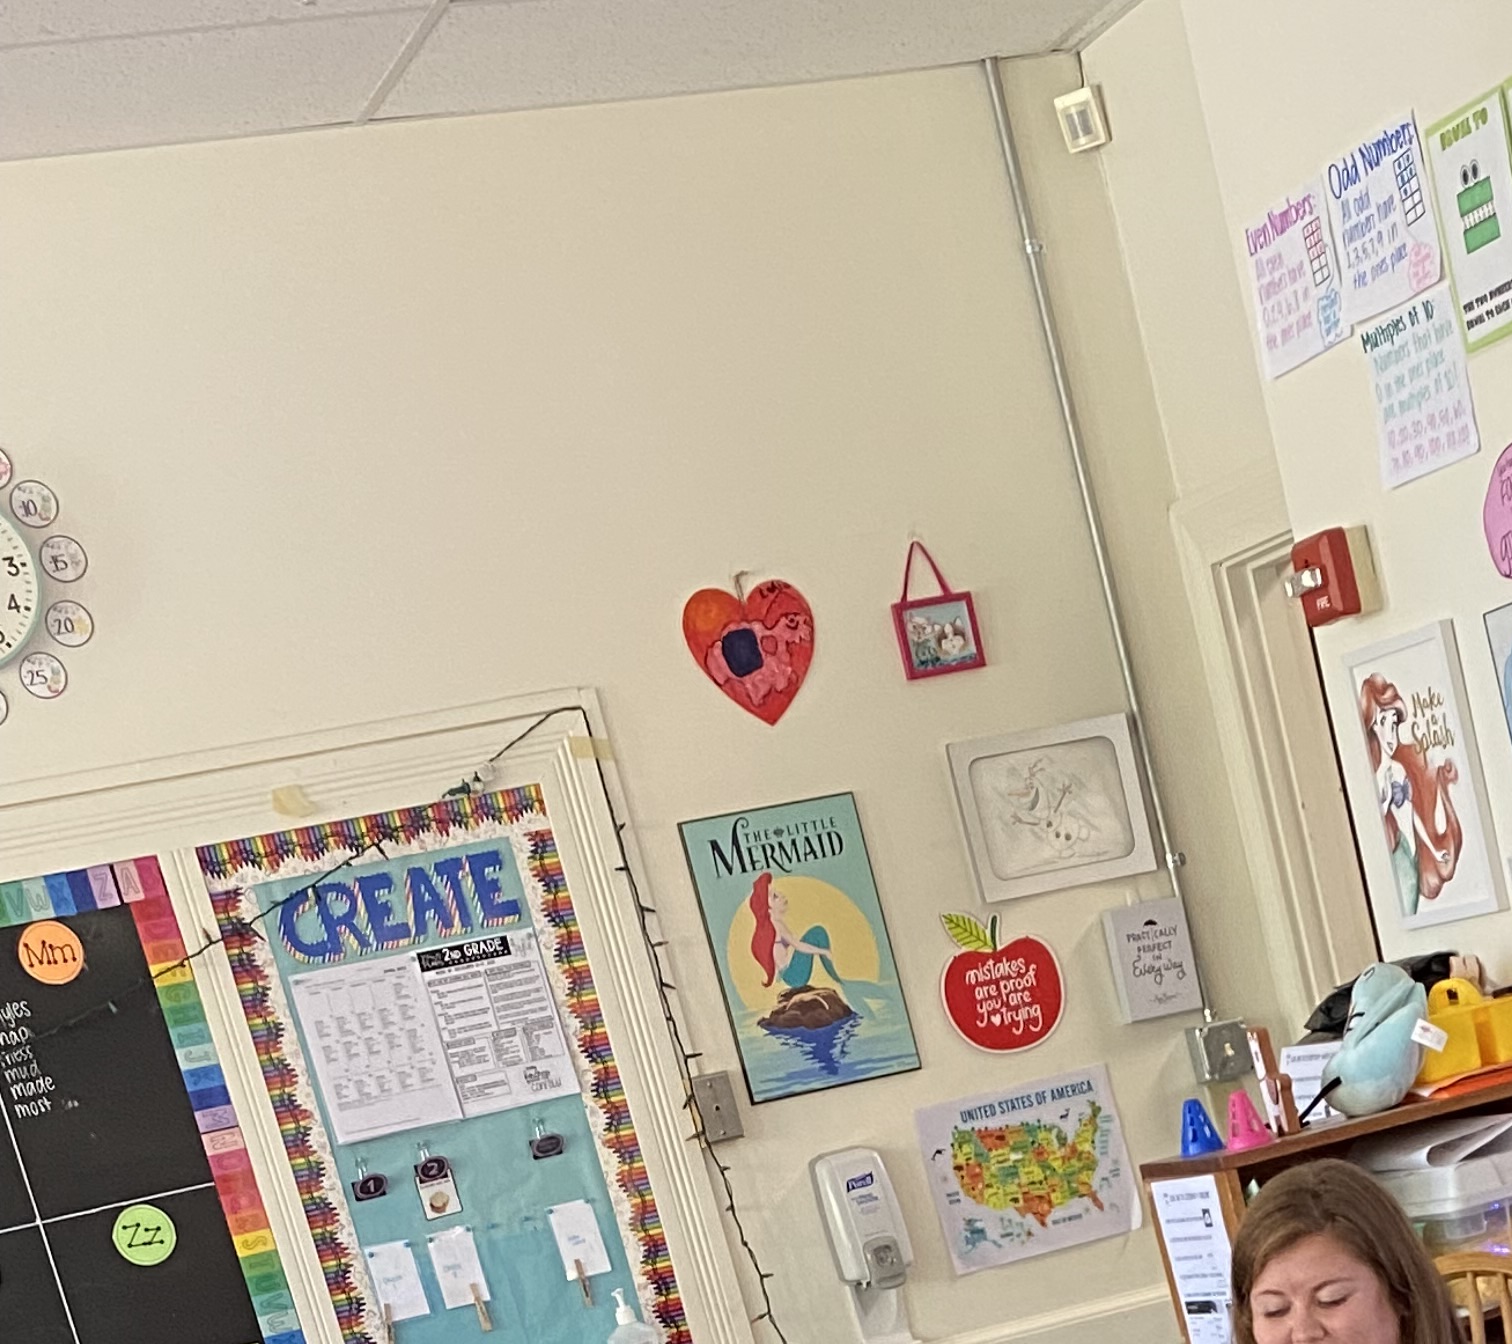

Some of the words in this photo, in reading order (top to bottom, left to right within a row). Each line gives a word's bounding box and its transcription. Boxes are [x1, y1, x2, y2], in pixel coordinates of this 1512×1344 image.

[1328, 154, 1360, 199] Odd
[1361, 313, 1406, 353] Multiples
[1409, 308, 1420, 327] of
[2, 557, 20, 576] 3
[8, 594, 20, 613] 4
[1412, 686, 1445, 719] Make
[1412, 712, 1456, 764] Splash
[744, 825, 773, 844] THE
[787, 816, 837, 839] LITTLE
[709, 817, 844, 880] MERMAID
[278, 850, 521, 964] CREATE
[23, 939, 77, 968] Mm
[441, 946, 461, 964] 2ND
[463, 936, 504, 960] GRADE
[966, 958, 1026, 986] mistakes
[975, 984, 998, 1000] are
[1000, 964, 1037, 1003] proof
[977, 1000, 1001, 1028] you
[1009, 990, 1032, 1005] are
[4, 1060, 41, 1083] mud
[10, 1076, 55, 1100] made
[960, 1101, 996, 1123] UNITED
[998, 1095, 1034, 1117] STATES
[1036, 1091, 1048, 1105] OF
[1051, 1080, 1094, 1102] AMERICA
[14, 1096, 52, 1119] most
[122, 1222, 165, 1248] Zz
